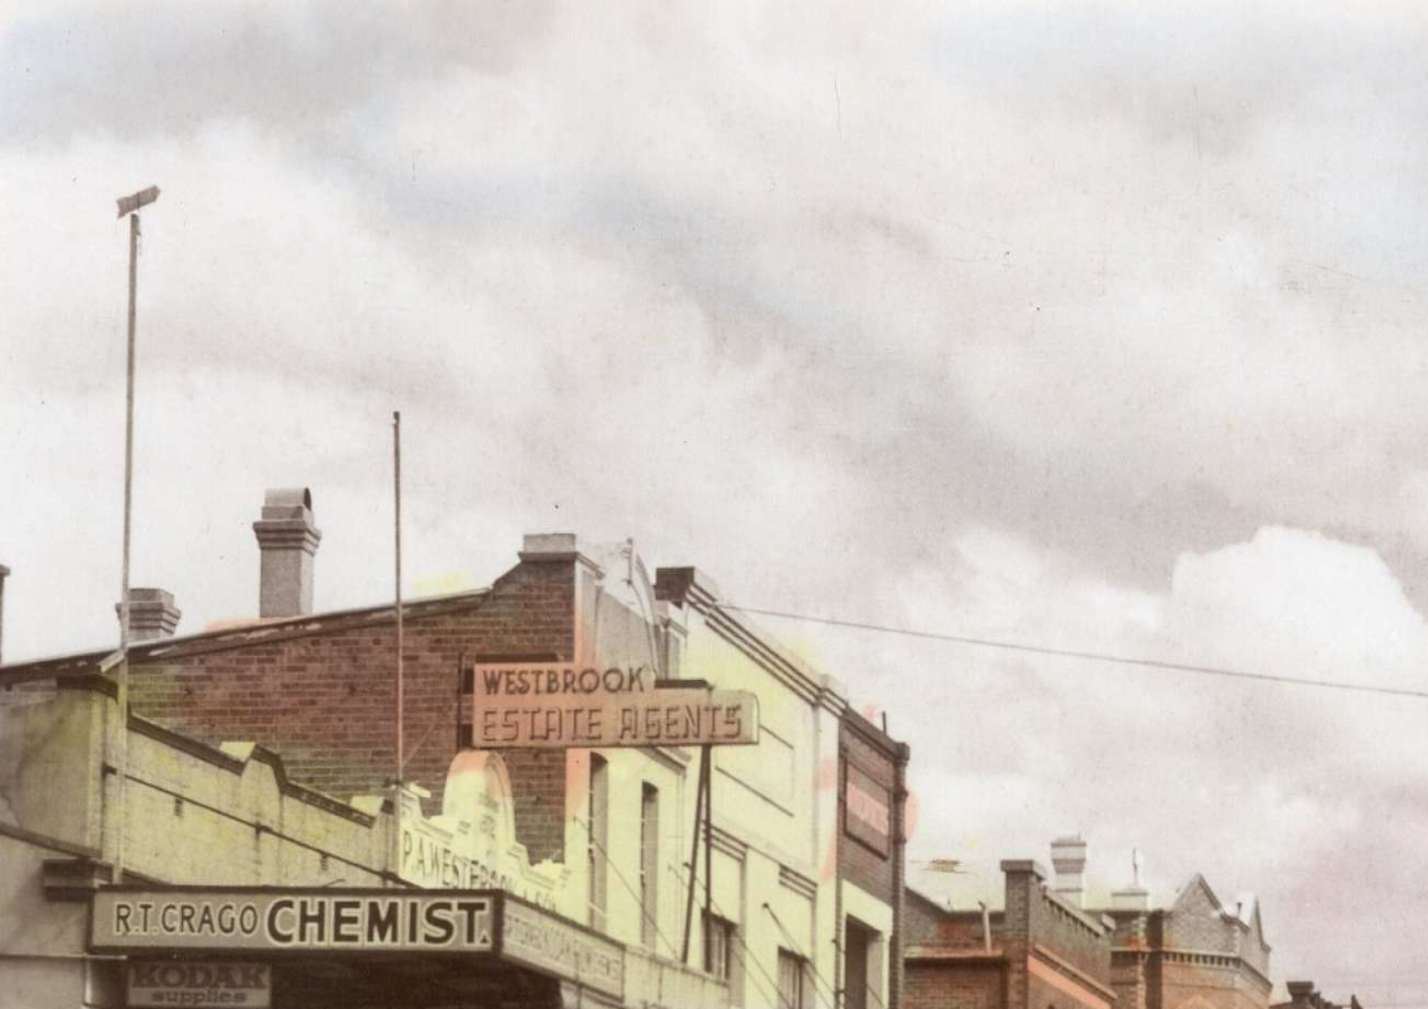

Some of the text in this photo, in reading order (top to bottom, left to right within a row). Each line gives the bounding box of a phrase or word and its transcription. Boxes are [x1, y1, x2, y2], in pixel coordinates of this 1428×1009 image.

[482, 667, 647, 695] WESTBROOK
[482, 703, 742, 742] ESTATE AGENTS
[132, 962, 267, 989] KODAK
[151, 989, 248, 1006] supplies
